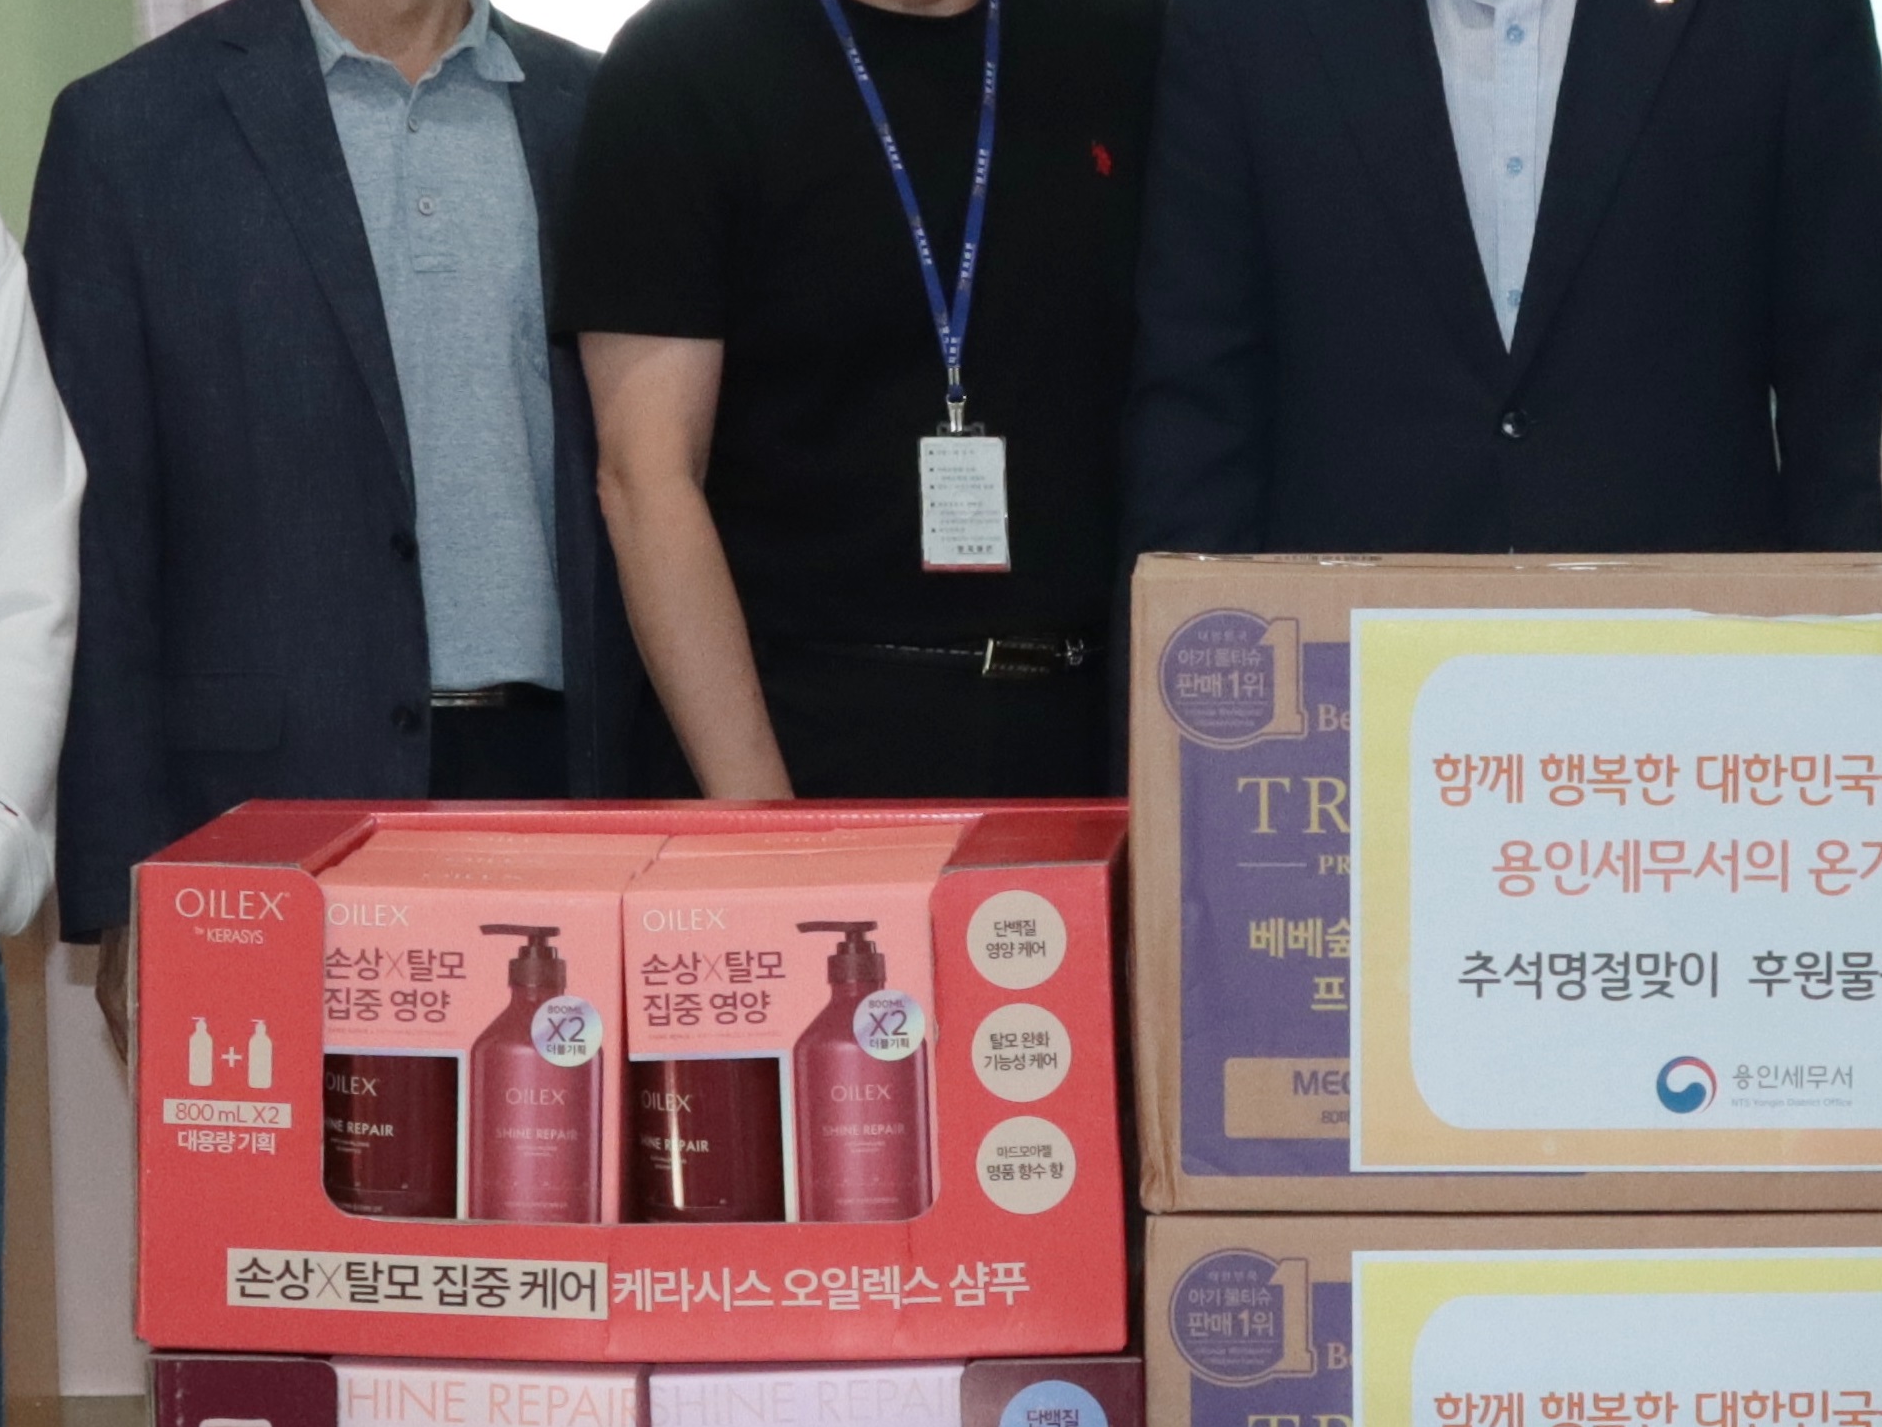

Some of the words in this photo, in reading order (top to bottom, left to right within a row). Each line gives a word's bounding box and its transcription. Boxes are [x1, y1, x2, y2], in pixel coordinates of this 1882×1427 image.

[1176, 672, 1222, 698] 판매
[1226, 670, 1265, 698] 1위
[1432, 754, 1524, 808] 함께
[1540, 754, 1680, 808] 행복한
[1491, 841, 1790, 896] 용인세무서의
[175, 889, 285, 922] OILEX
[327, 904, 408, 927] OILEX
[643, 909, 726, 931] OILEX
[993, 920, 1037, 938] 단백질
[206, 928, 264, 944] KERASYS
[986, 940, 1015, 959] 영양
[1017, 939, 1047, 958] 케어
[1458, 951, 1720, 1001] 추석명절맞이
[325, 989, 383, 1022] 집중
[391, 990, 451, 1023] 영양
[642, 993, 702, 1026] 집중
[710, 992, 771, 1024] 영양
[548, 1017, 586, 1043] X2
[990, 1032, 1019, 1050] 탈모
[1021, 1031, 1051, 1049] 완화
[984, 1053, 1027, 1072] 기능성
[1028, 1052, 1058, 1070] 케어
[1732, 1064, 1854, 1090] 용인세무서
[506, 1088, 565, 1106] OILEX
[1732, 1098, 1752, 1107] NTS
[176, 1104, 214, 1123] 800
[251, 1106, 280, 1124] X2
[347, 1122, 394, 1137] REPAIR
[496, 1128, 534, 1140] SHINE
[536, 1129, 578, 1140] REPAIR
[178, 1132, 235, 1153] 대용량
[238, 1132, 275, 1154] 기획
[986, 1163, 1015, 1182] 명품
[1017, 1162, 1047, 1181] 향수
[1049, 1161, 1065, 1180] 향
[434, 1265, 511, 1309] 집중
[520, 1269, 597, 1311] 케어
[614, 1266, 771, 1312] 케라시스
[781, 1266, 941, 1310] 오일렉스
[949, 1263, 1030, 1308] 샴푸
[343, 1381, 467, 1425] HINE
[652, 1381, 796, 1427] SHINE
